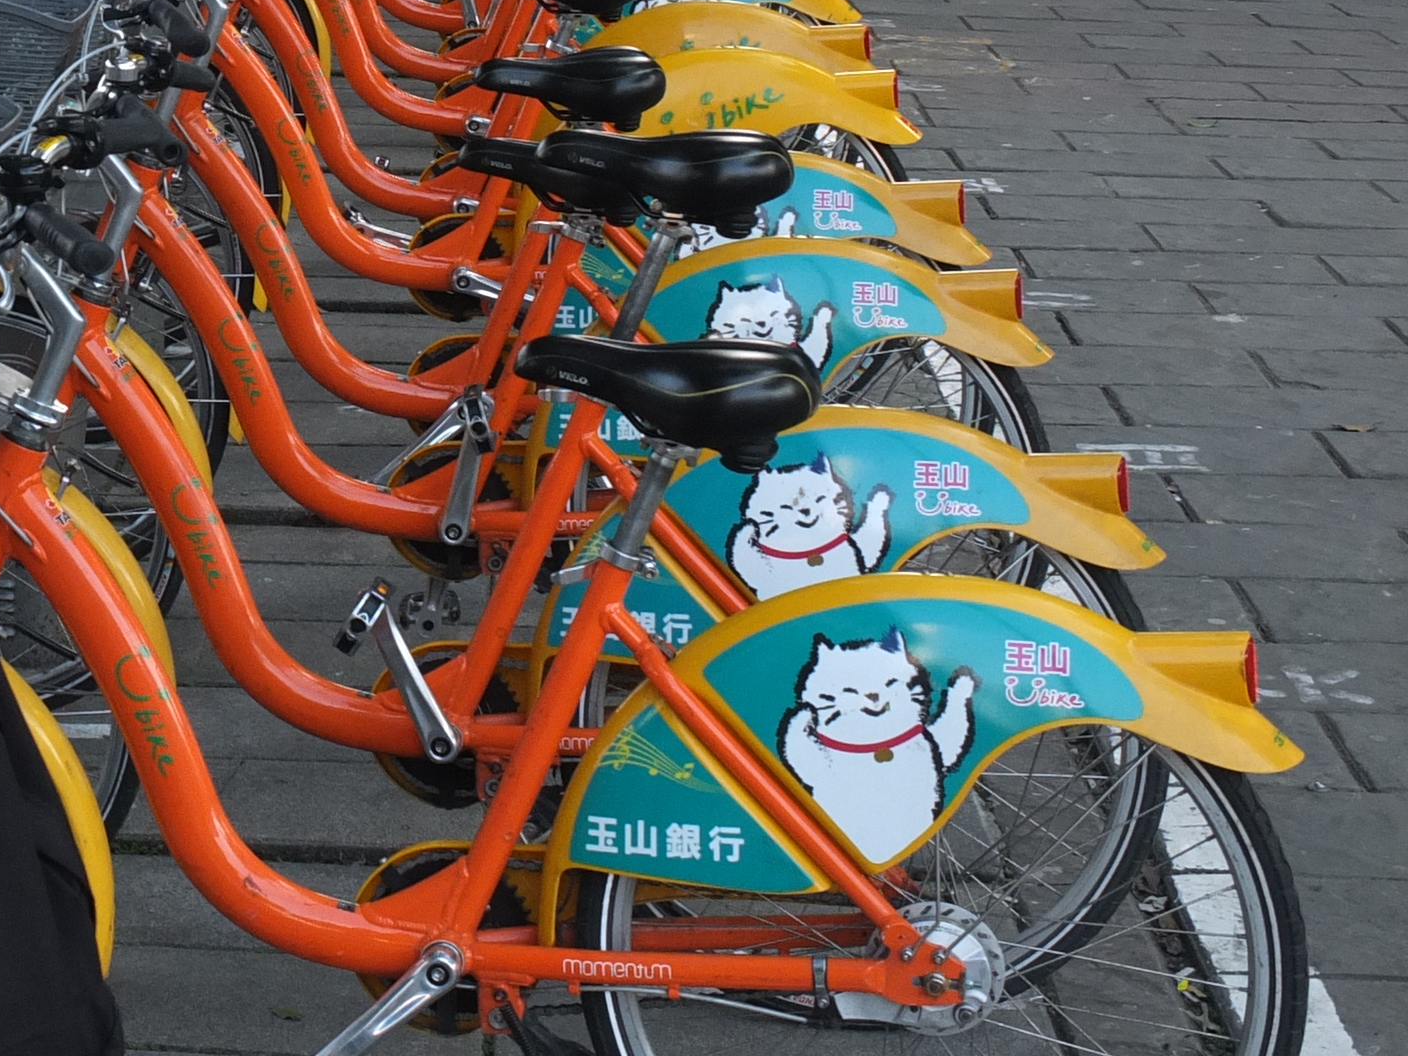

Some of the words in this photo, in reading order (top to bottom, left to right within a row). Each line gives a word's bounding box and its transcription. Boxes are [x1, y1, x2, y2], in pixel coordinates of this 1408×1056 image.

[813, 189, 854, 212] 玉山
[852, 281, 899, 306] 玉山
[558, 370, 589, 386] VELO
[914, 460, 969, 490] 玉山
[1004, 640, 1070, 676] 玉山
[585, 815, 745, 863] 玉山銀行
[562, 957, 673, 980] momentum
